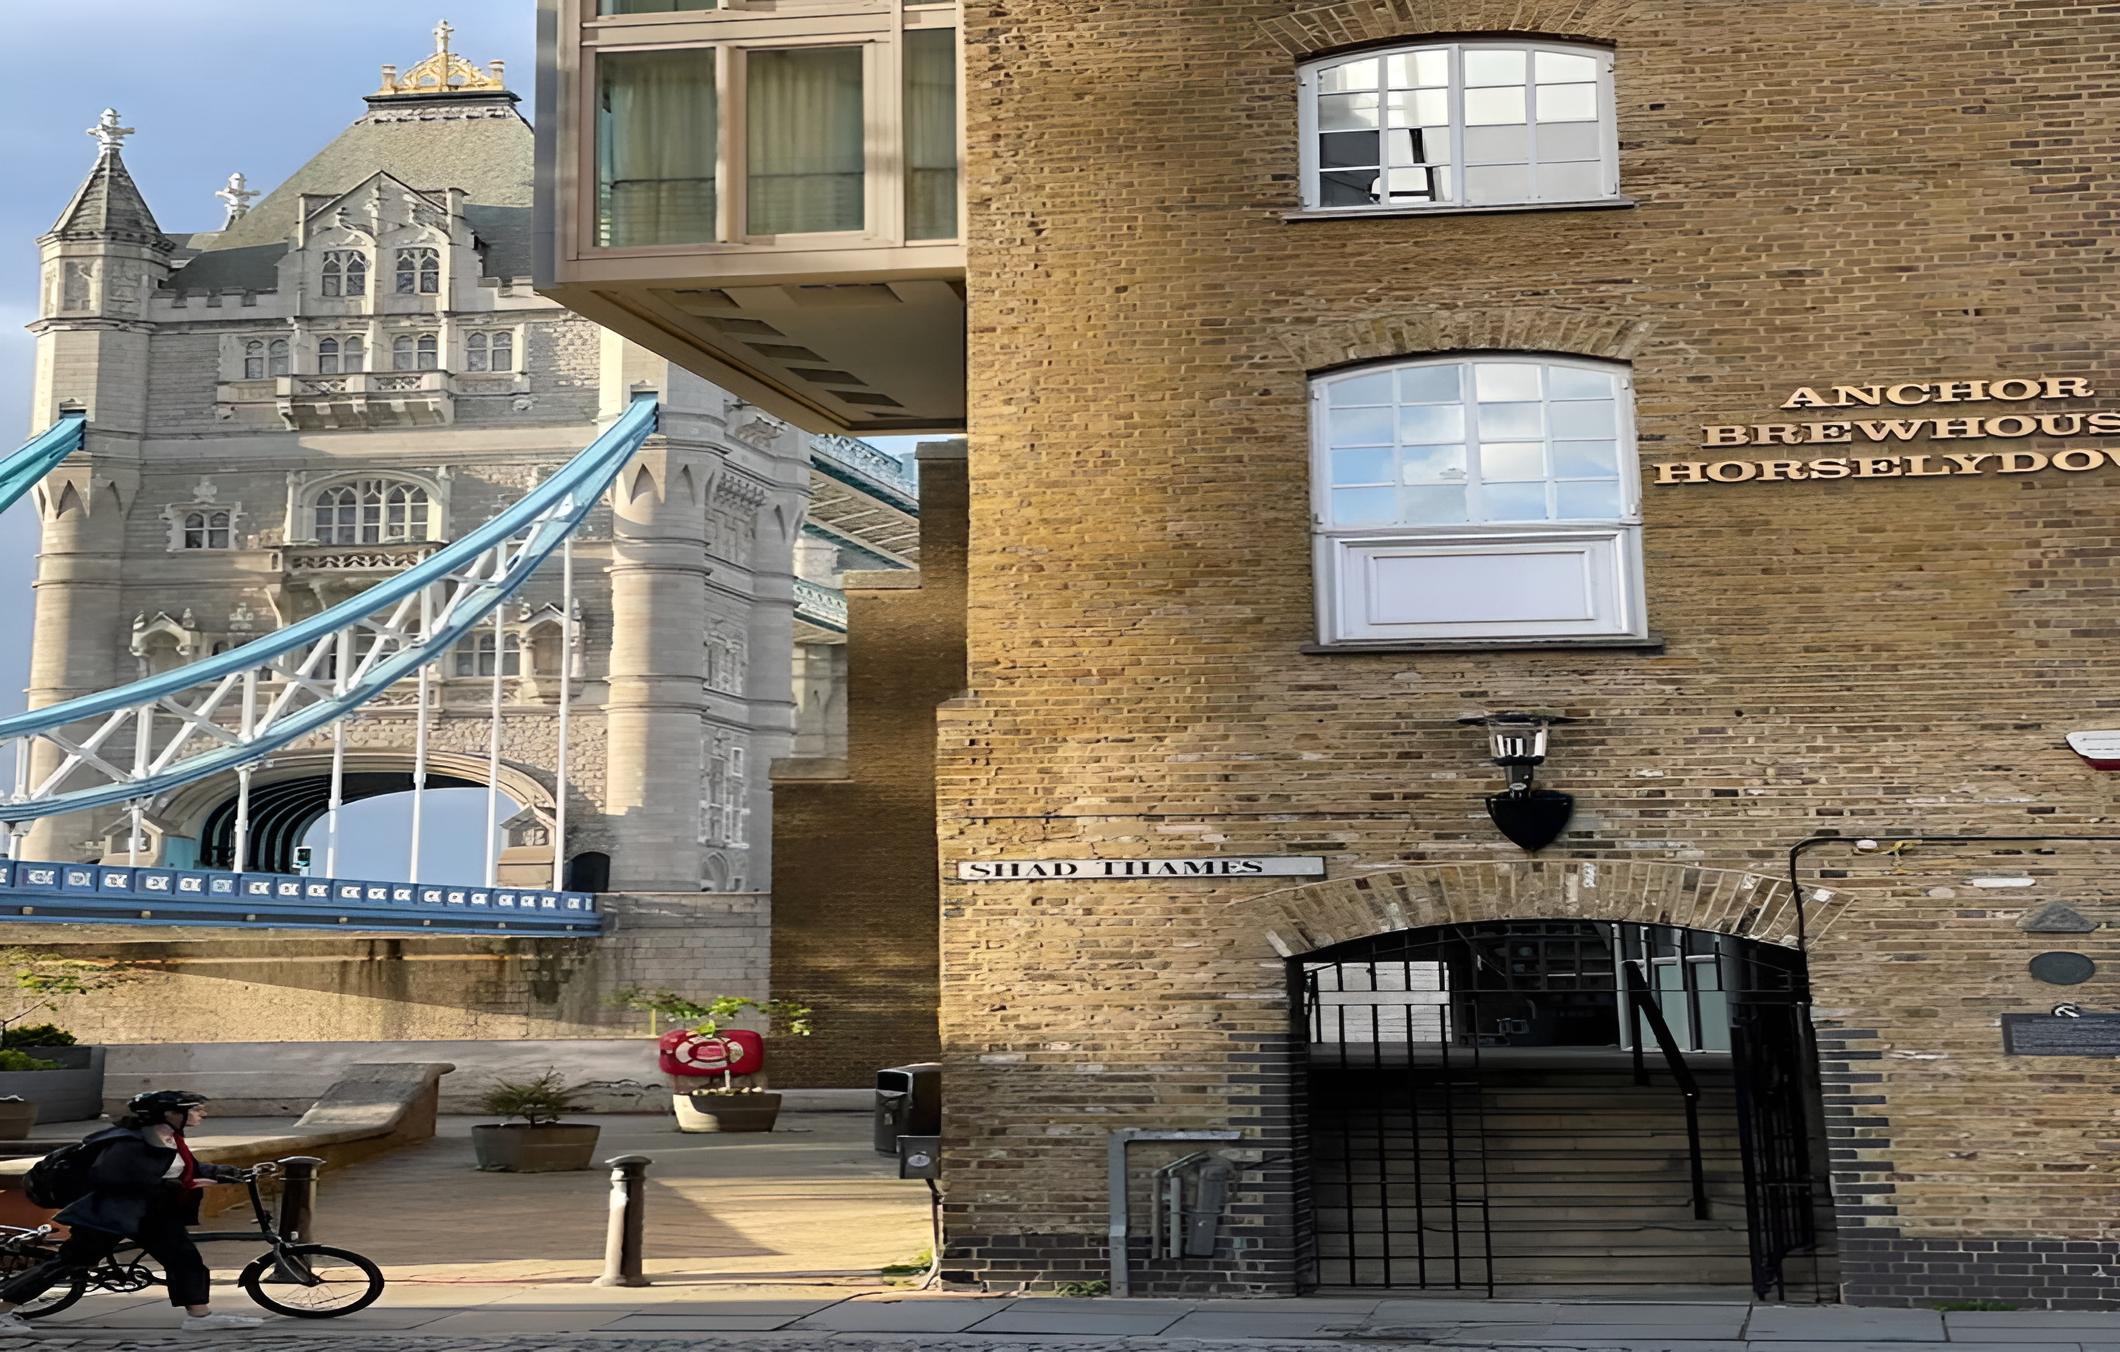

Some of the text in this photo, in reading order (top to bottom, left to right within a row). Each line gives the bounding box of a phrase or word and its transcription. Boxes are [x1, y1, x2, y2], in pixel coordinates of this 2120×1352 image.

[1781, 377, 2095, 409] ANCHOR
[1701, 413, 2120, 447] BREWHOUS
[1653, 448, 2120, 484] HORSELYDO
[969, 860, 1264, 877] SHAD THAMES
